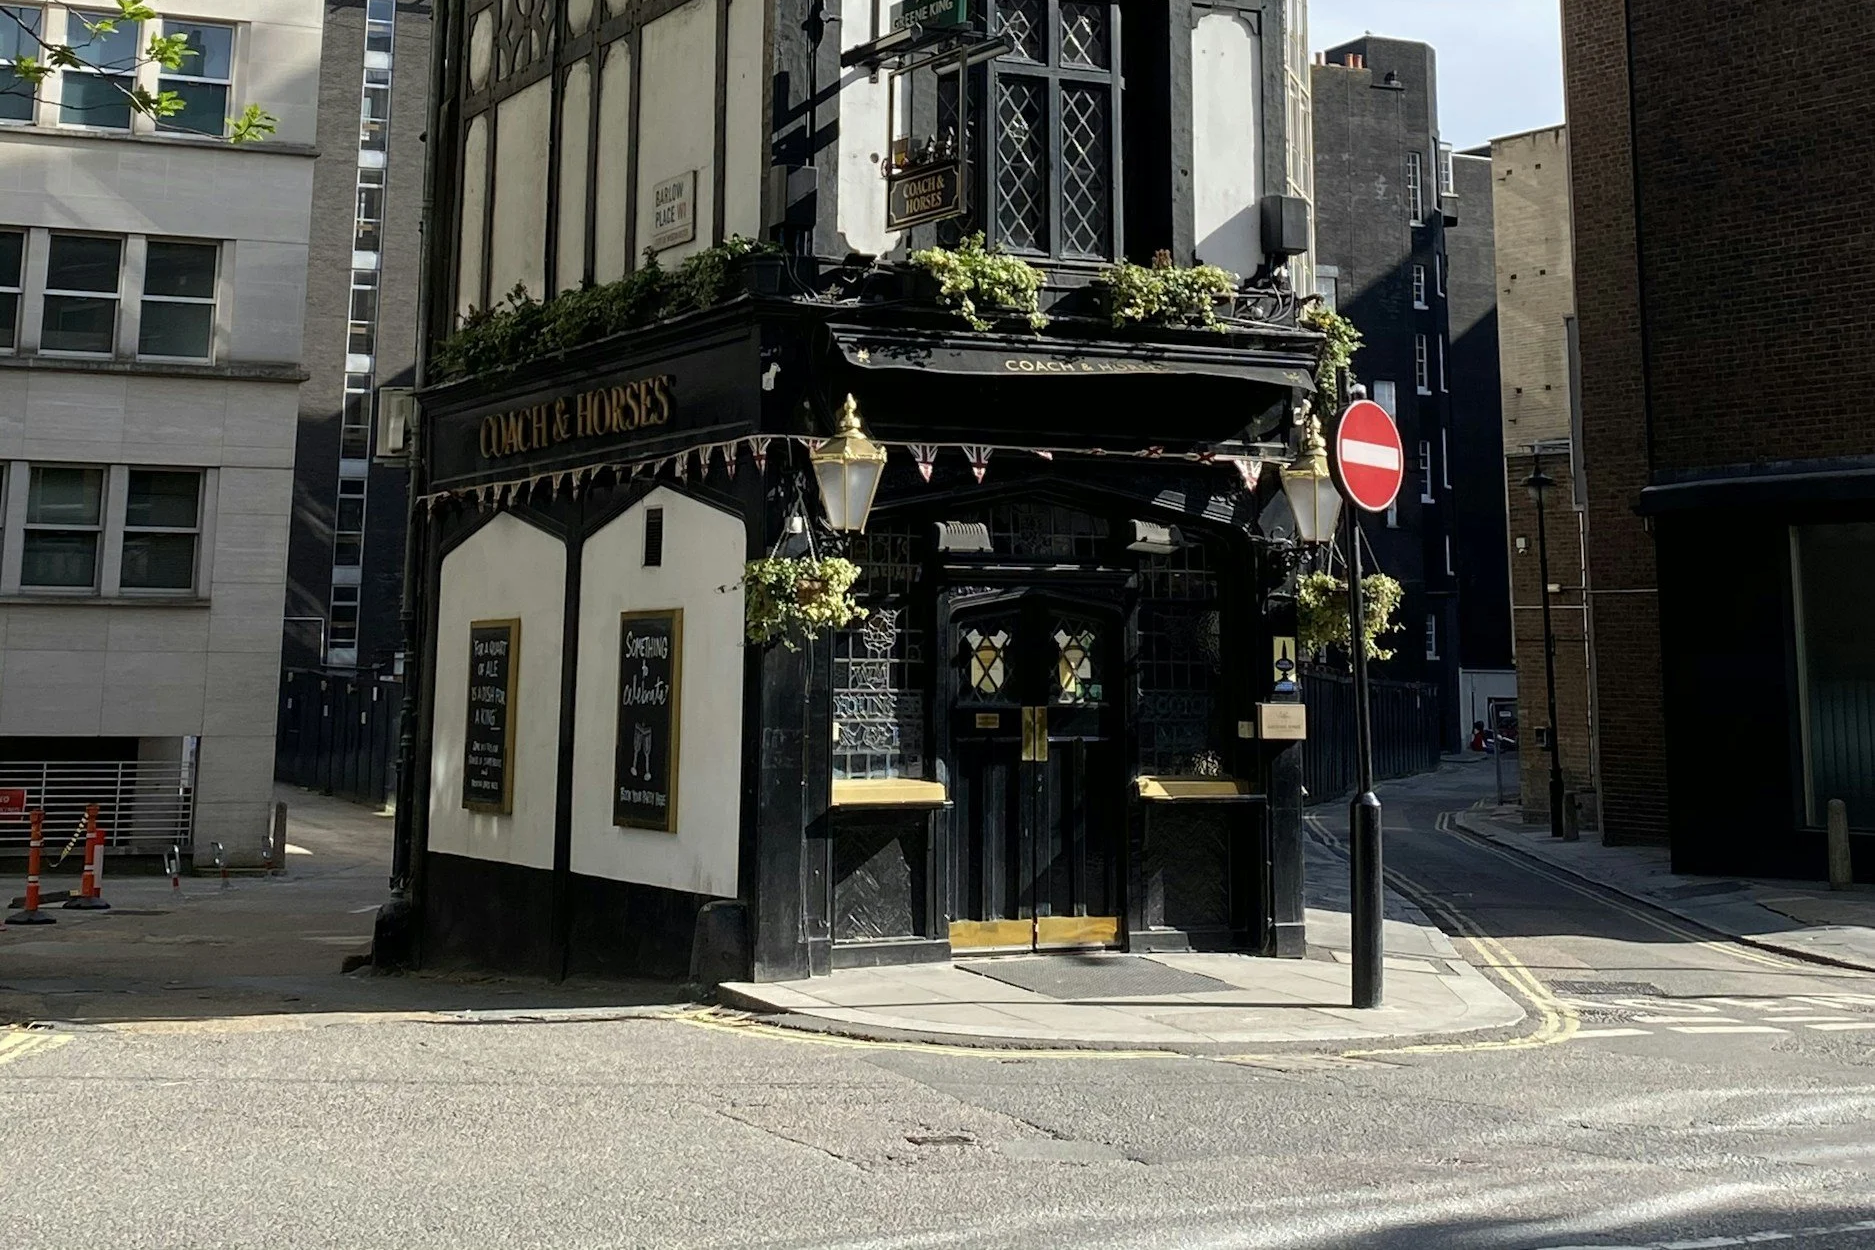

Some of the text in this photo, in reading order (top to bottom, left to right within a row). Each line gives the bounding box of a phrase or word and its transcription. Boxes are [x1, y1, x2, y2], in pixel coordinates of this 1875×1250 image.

[892, 6, 928, 29] GREENE
[655, 181, 684, 207] BARLOW
[903, 175, 945, 198] COACH &
[905, 191, 942, 215] HORSES
[655, 206, 675, 229] PLACE
[1005, 360, 1075, 372] COACH
[1081, 362, 1093, 371] &
[480, 374, 670, 459] COACH & HORSES
[625, 630, 668, 659] SOMETHING
